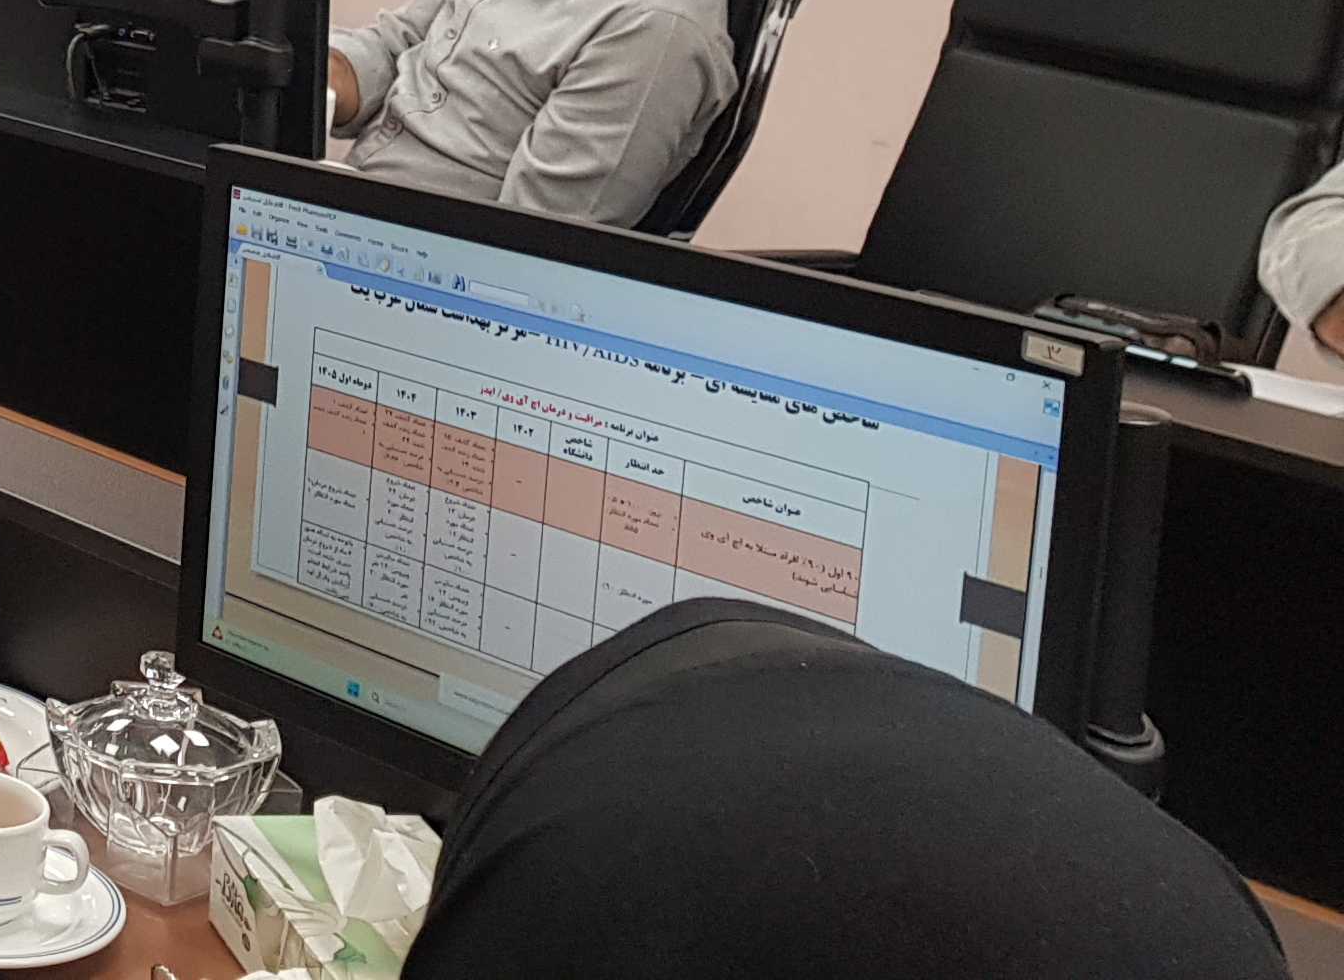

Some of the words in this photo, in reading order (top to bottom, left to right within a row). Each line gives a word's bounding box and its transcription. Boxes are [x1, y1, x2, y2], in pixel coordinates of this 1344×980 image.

[502, 393, 515, 404] وی
[516, 394, 528, 406] آی
[454, 406, 478, 420] ۱۴۰۳
[542, 404, 566, 417] درمان
[575, 413, 603, 428] مراقبت
[513, 424, 534, 438] ۱۴۰۲
[610, 422, 634, 437] برنامه
[565, 436, 593, 448] شاخص
[635, 430, 660, 443] عنوان
[562, 448, 593, 462] دانشگاه
[625, 458, 650, 472] انتظار
[651, 466, 664, 476] حد
[742, 496, 773, 508] شاخص
[775, 504, 802, 517] عنوان
[222, 872, 244, 922] Bita
